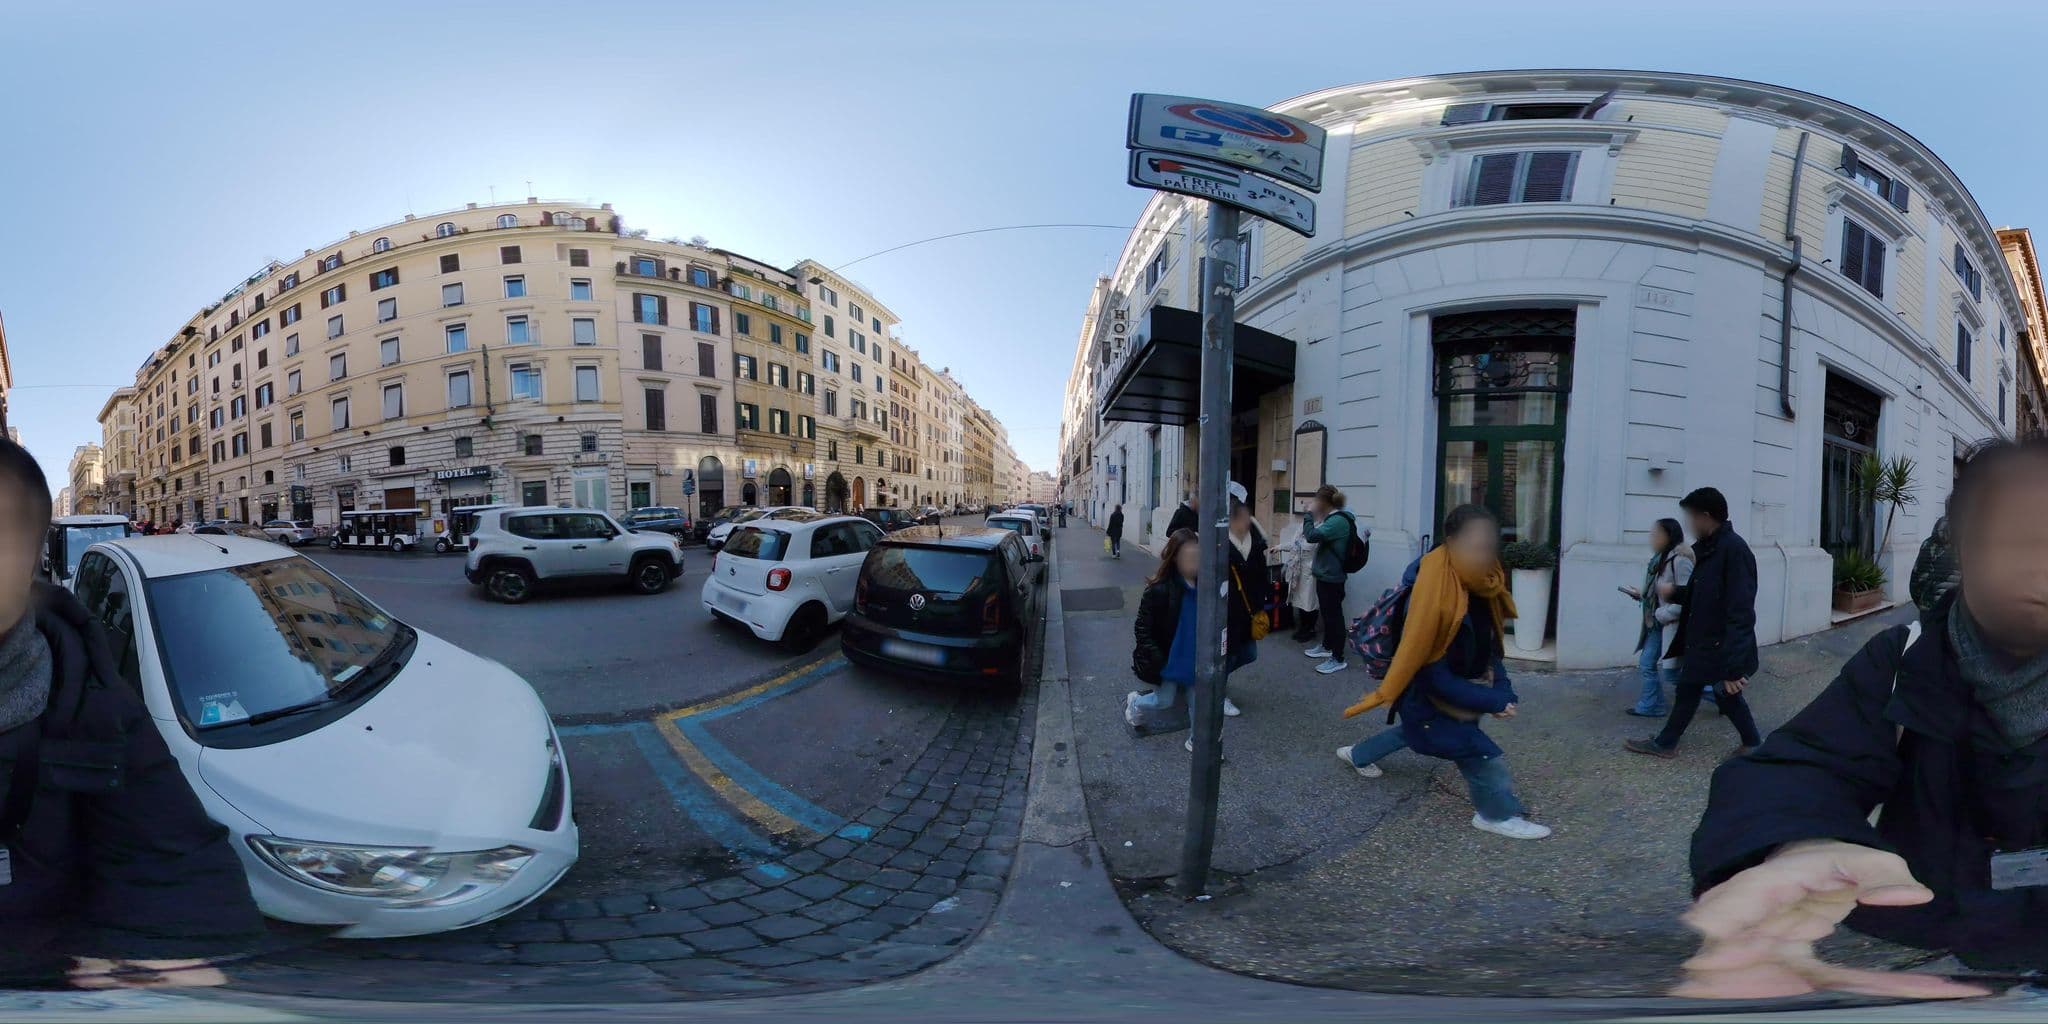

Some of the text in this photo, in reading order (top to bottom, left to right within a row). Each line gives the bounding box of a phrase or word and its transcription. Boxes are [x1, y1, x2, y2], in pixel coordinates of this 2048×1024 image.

[1163, 179, 1239, 200] PALESTINE
[1181, 175, 1224, 190] FREE
[1263, 187, 1296, 205] max
[437, 467, 474, 480] HOTEL
